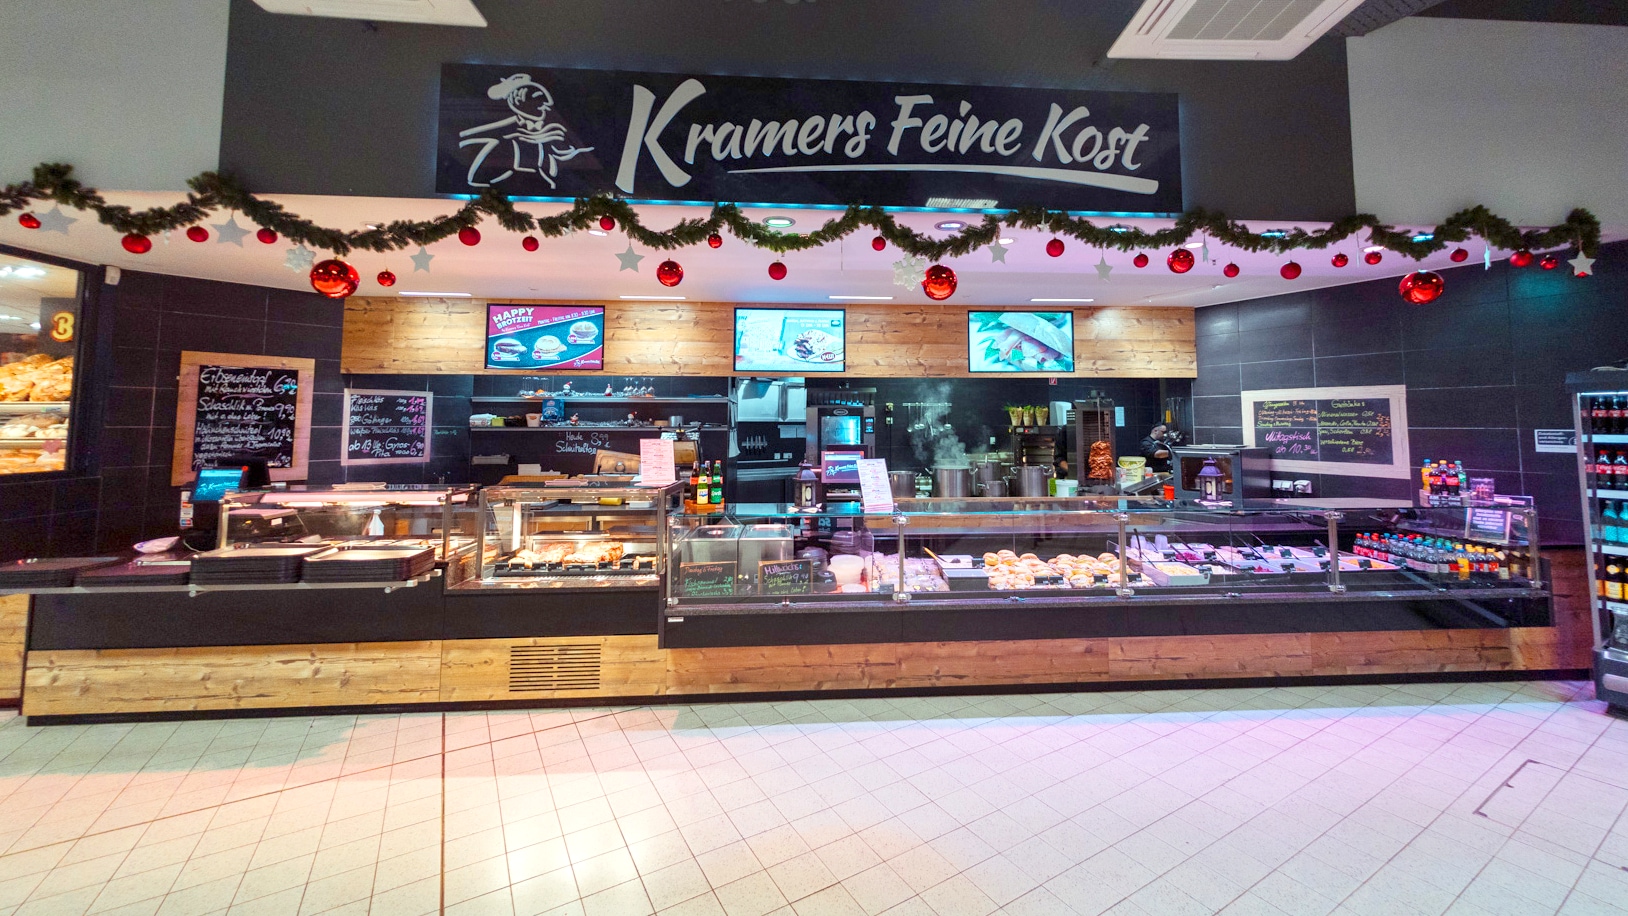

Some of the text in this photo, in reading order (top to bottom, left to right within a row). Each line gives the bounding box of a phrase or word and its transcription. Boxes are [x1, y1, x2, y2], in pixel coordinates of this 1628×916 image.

[615, 78, 1152, 195] Kramers Feine Kost
[492, 307, 535, 324] HAPPY
[496, 316, 533, 330] BROTZEIT
[197, 397, 246, 412] Schaschlik
[348, 439, 362, 452] ab
